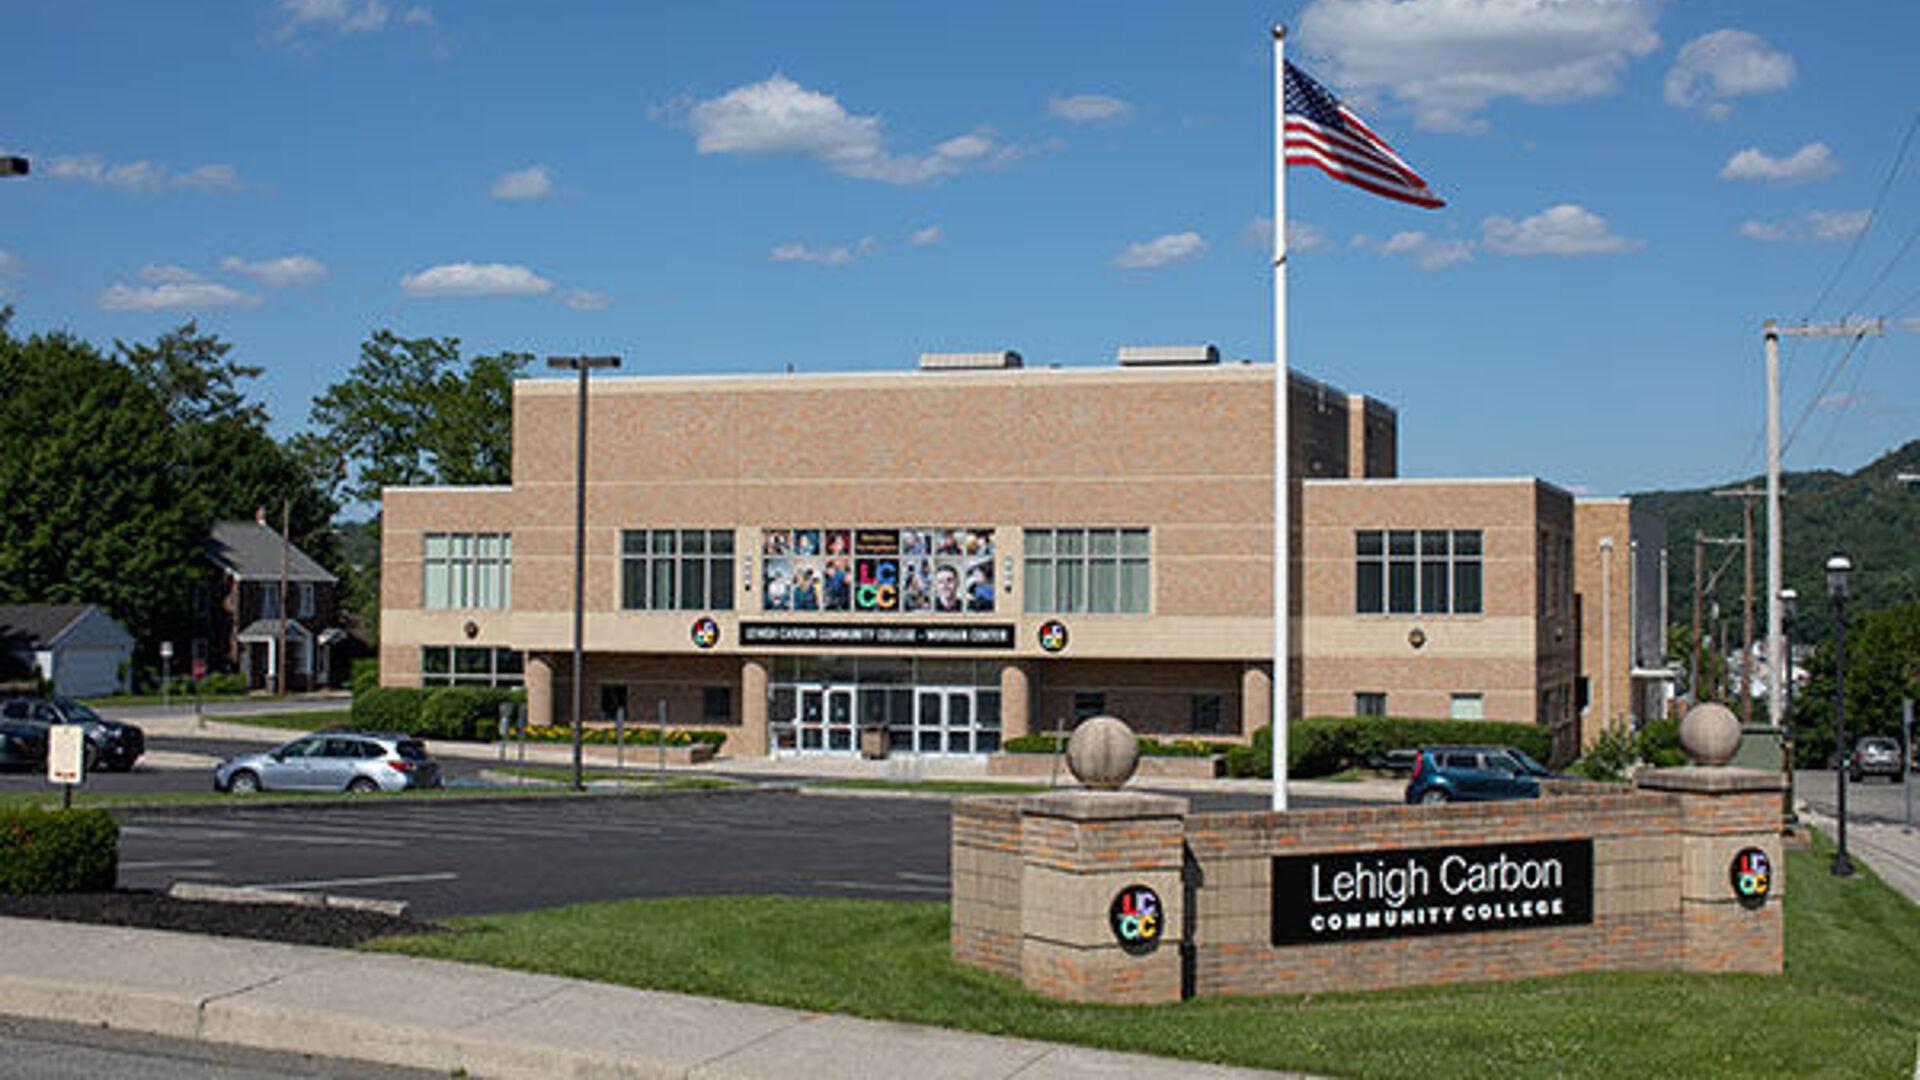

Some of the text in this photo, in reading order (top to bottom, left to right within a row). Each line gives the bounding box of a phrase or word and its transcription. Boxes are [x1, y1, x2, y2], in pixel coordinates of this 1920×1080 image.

[1311, 853, 1563, 908] Lehigh Carbon
[1310, 899, 1563, 931] COMMUNITY COLLEGE
